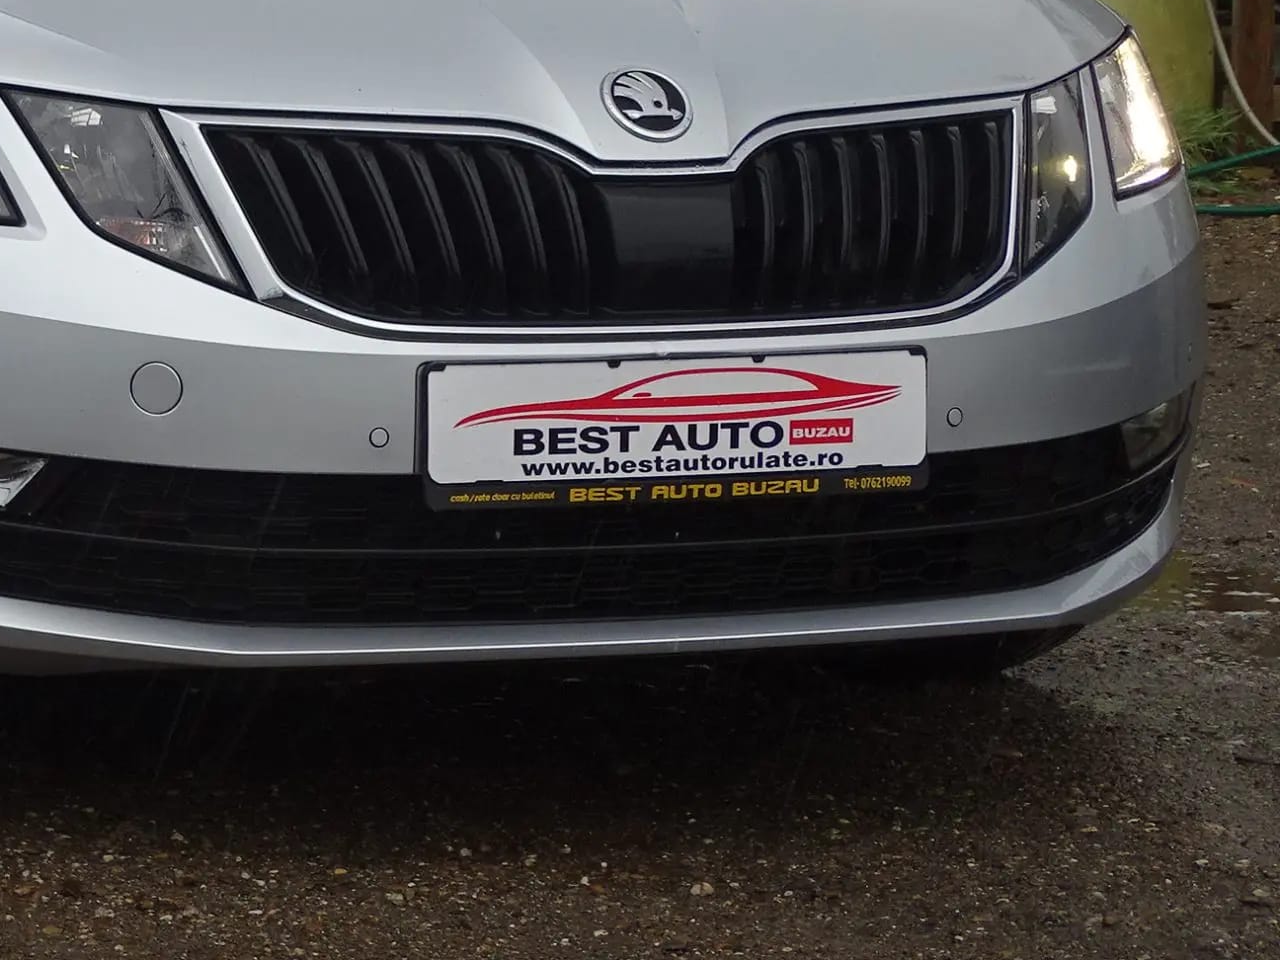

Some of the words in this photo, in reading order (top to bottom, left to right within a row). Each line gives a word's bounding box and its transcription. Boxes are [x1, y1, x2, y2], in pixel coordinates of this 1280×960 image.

[513, 426, 640, 456] BEST
[651, 420, 784, 452] AUTO
[792, 426, 851, 439] BUZAU
[521, 451, 844, 477] www.bestautorulate.ro
[569, 487, 642, 503] BEST
[651, 483, 723, 500] AUTO
[732, 478, 820, 497] BUZAU
